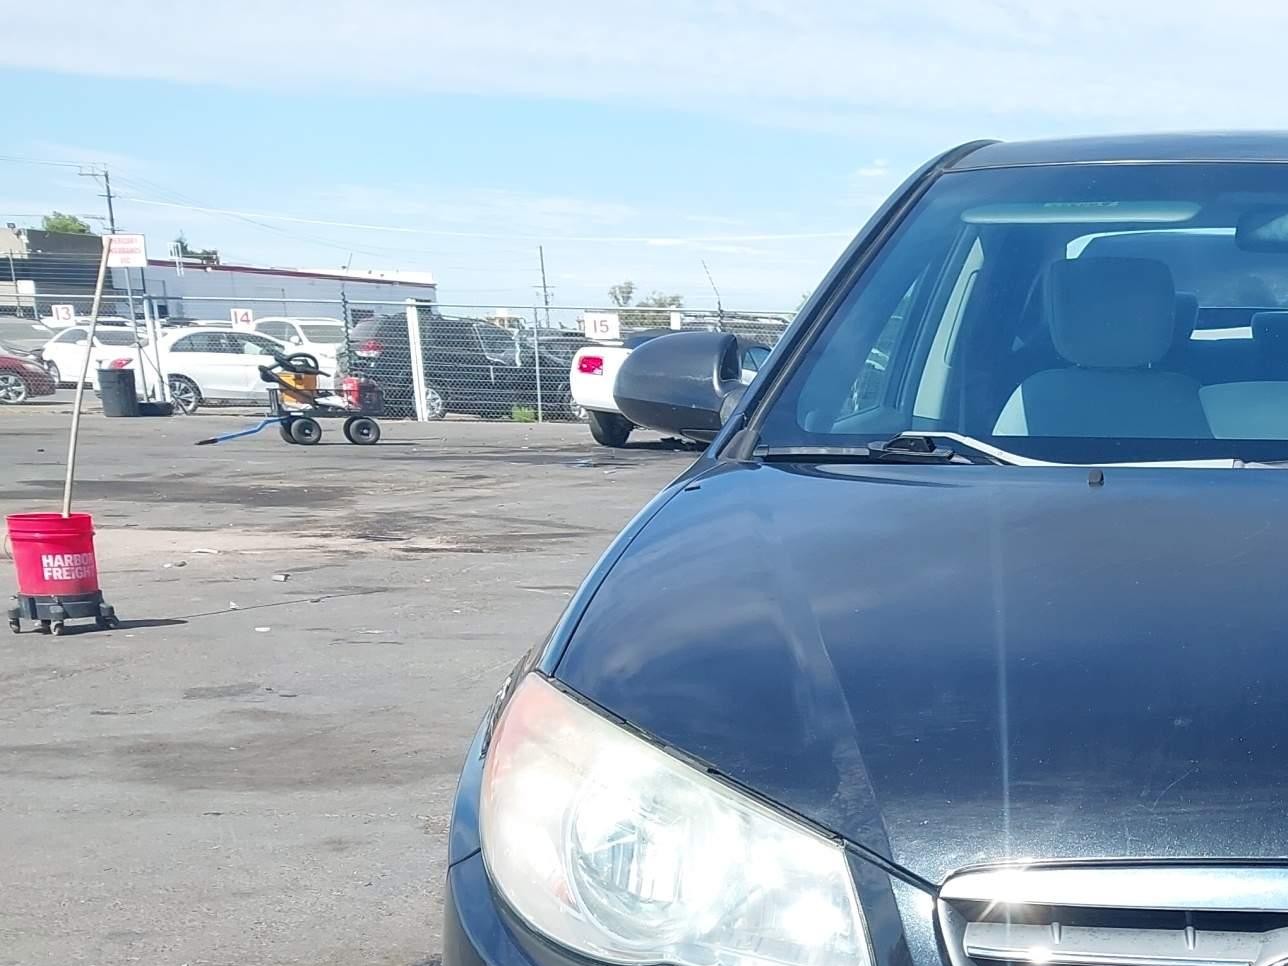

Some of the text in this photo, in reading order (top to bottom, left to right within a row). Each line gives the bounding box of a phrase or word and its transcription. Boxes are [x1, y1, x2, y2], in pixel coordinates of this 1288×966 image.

[55, 306, 71, 320] 13
[234, 311, 251, 325] 14
[593, 319, 609, 333] 15
